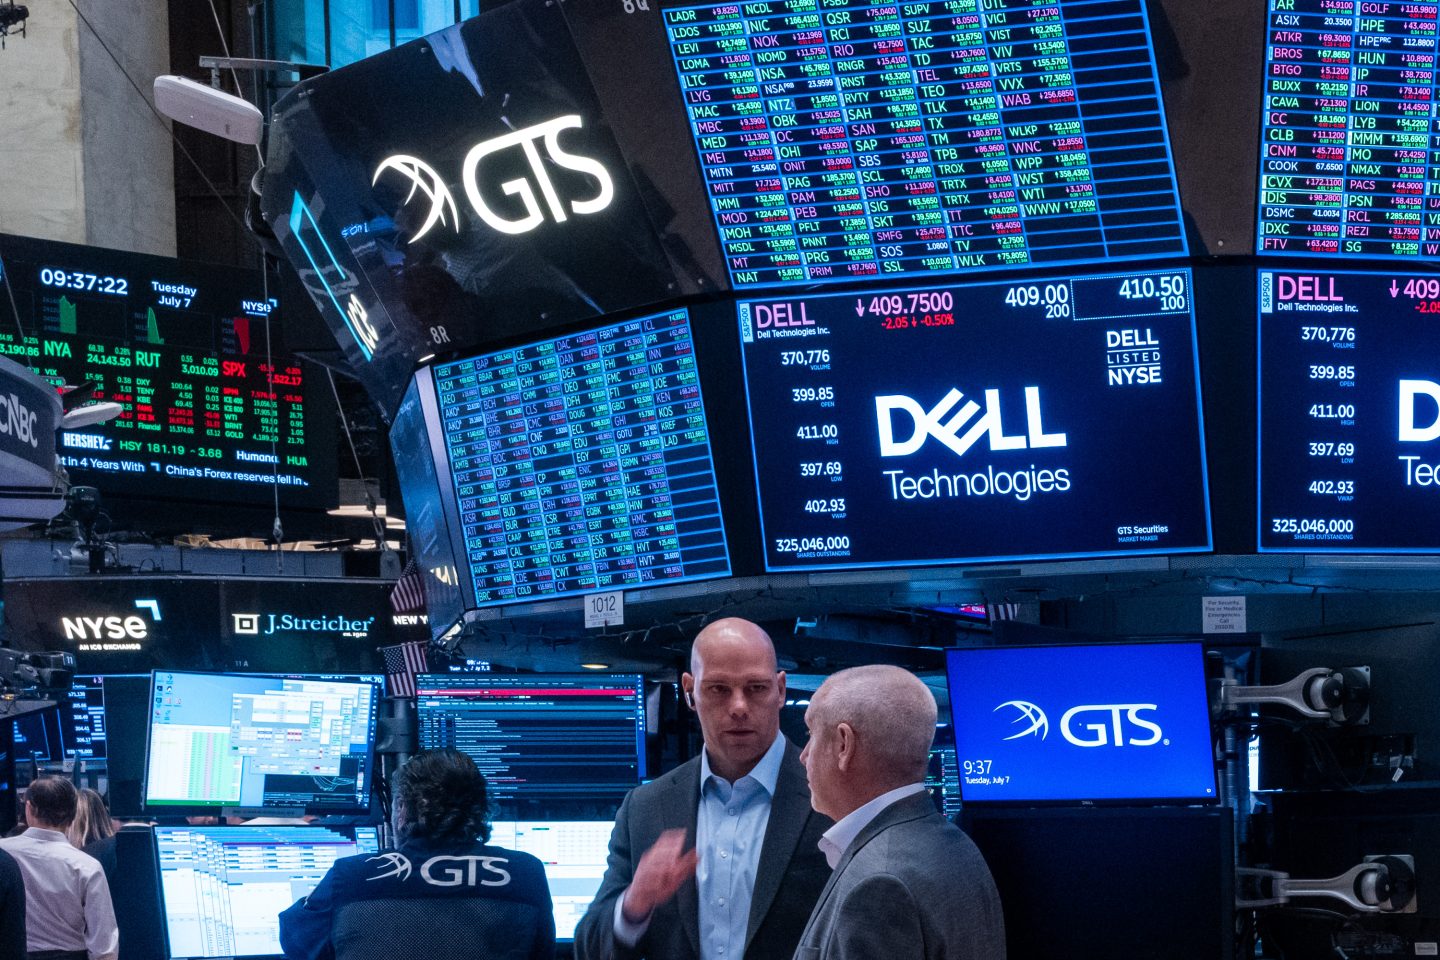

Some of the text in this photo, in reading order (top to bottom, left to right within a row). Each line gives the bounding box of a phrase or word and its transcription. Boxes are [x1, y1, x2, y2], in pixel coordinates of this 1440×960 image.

[670, 11, 696, 22] LADR
[826, 12, 851, 24] QSR
[1276, 16, 1352, 26] ASIX 20.3500
[1360, 20, 1385, 32] HPE
[753, 36, 780, 48] NOK
[1274, 48, 1302, 60] BROS
[1003, 93, 1032, 106] WAB
[1268, 160, 1298, 171] COOK
[462, 114, 614, 234] GTS
[1025, 202, 1060, 216] WWW
[41, 268, 128, 295] 09:37:22
[736, 272, 758, 284] NAT
[152, 281, 197, 296] Tuesday
[1278, 276, 1344, 301] DELL
[158, 295, 191, 308] July 7
[755, 275, 1184, 329] DELL 409.7500 409.00 410.50
[1162, 296, 1186, 311] 100
[1278, 302, 1359, 313] Dell Technologies Inc.
[1046, 302, 1070, 318] 200
[431, 325, 450, 345] 8R
[1106, 328, 1159, 348] DELL
[1302, 327, 1356, 342] 370,776
[44, 341, 131, 367] NYA 24,143.50
[780, 349, 830, 366] 370,776
[1108, 350, 1161, 364] LISTED
[136, 352, 218, 377] RUT 3,010.09
[222, 361, 246, 377] SPX
[1108, 366, 1162, 386] NYSE
[1310, 366, 1355, 380] 399.85
[792, 386, 834, 402] 399.85
[1309, 404, 1354, 418] 411.00
[875, 386, 1067, 457] DELL
[796, 424, 838, 440] 411.00
[64, 433, 105, 449] HERSHEY
[120, 441, 142, 450] HSY
[147, 444, 184, 455] 181.19
[198, 447, 222, 458] 3.68
[1309, 442, 1354, 457] 397.69
[68, 458, 145, 472] in 4 Years With
[800, 461, 842, 477] 397.69
[166, 464, 302, 485] China's Forex reserves fell in
[883, 464, 1070, 501] Technologies
[1309, 480, 1354, 495] 402.93
[804, 498, 846, 514] 402.93
[1272, 518, 1354, 534] 325,046,000
[776, 536, 850, 553] 325,046,000
[592, 595, 616, 613] 1012
[264, 614, 372, 634] J.Streicher
[393, 616, 418, 624] NEW
[1060, 703, 1163, 747] GTS
[964, 760, 993, 775] 9:37
[965, 776, 1005, 786] Tuesday, July
[420, 854, 512, 888] GTS
